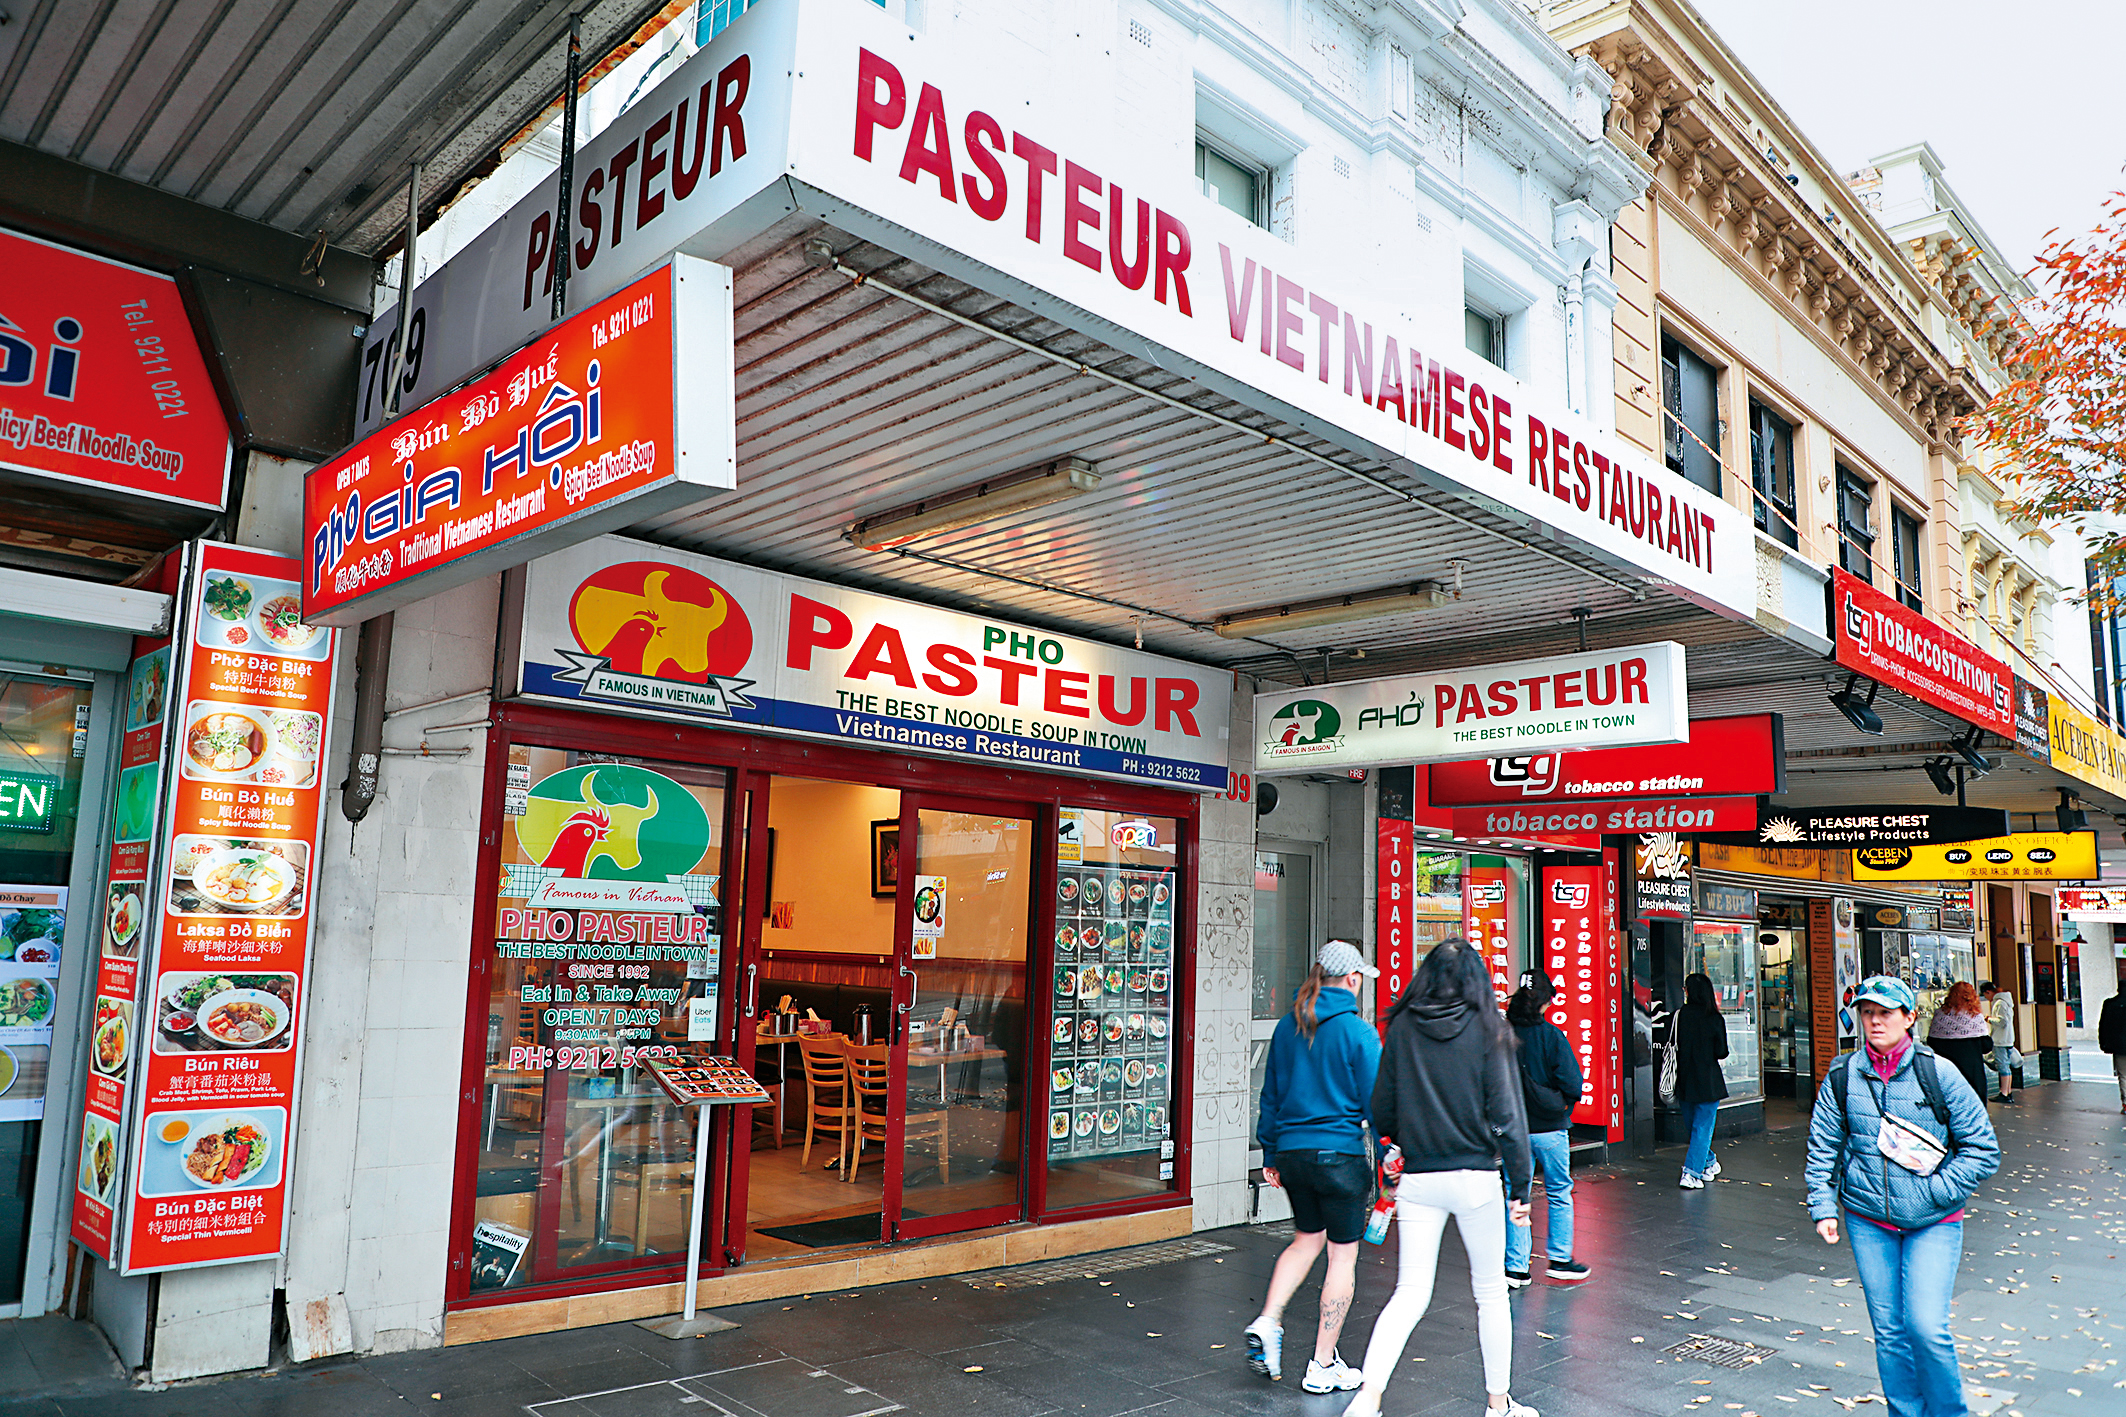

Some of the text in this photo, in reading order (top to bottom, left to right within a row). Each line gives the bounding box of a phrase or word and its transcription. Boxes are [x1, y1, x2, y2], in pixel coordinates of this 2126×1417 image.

[591, 293, 654, 349] Tel. 9211 0221
[853, 46, 1715, 574] PASTEUR VIETNAMESE RESTAURANT
[121, 299, 189, 419] Tel. 9211 0221
[0, 409, 182, 479] icy Beef Noodle Soup
[391, 419, 450, 465] Bún
[336, 455, 370, 492] OPEN 7 DAYS
[565, 440, 655, 505] Spicy Beef Noodle Soup
[400, 479, 545, 568] Traditional Vietnamese Restaurant
[983, 626, 1064, 665] PHO
[210, 652, 313, 679] Phở Đặc Biệt
[786, 592, 1201, 738] PASTEUR
[223, 669, 297, 691] 特別牛肉粉
[209, 682, 307, 701] Special Beef Noodle Soup
[598, 678, 716, 707] FAMOUS IN VIETNAM
[1434, 657, 1650, 729] PASTEUR
[836, 690, 1147, 755] THE BEST NOODLE SOUP IN TOWN
[1453, 713, 1636, 743] THE BEST NOODLE IN TOWN
[836, 713, 1082, 767] Vietnamese Restaurant
[1275, 747, 1299, 756] FAMOUS
[1307, 744, 1331, 752] SAIGON
[2052, 714, 2099, 769] ACEBEN
[1147, 761, 1173, 779] 9212
[1175, 765, 1201, 782] 5622
[1565, 775, 1704, 795] tobacco station
[201, 788, 295, 807] Bún Bò Huế
[199, 817, 291, 831] Spicy Beef Noodle Soup
[1486, 805, 1715, 833] tobacco station
[1810, 814, 1930, 829] PLEASURE CHEST
[1111, 826, 1156, 852] open
[1810, 829, 1930, 842] Lifestyle Products
[1860, 848, 1908, 858] ACEBEN
[2030, 852, 2053, 860] SELL
[13, 894, 36, 905] Chay
[541, 882, 685, 903] Famous in Vietnam
[1551, 879, 1590, 909] tsg
[1638, 880, 1690, 897] PLEASURE CHEST
[1638, 897, 1690, 912] Lifestyle Products
[1706, 892, 1745, 912] WE BUY
[1390, 836, 1401, 993] TOBACCO
[176, 921, 291, 938] Laksa Đồ Biển
[499, 907, 708, 945] PHO PASTEUR
[497, 942, 708, 962] THE BEST NOODLE IN TOWN
[1636, 938, 1647, 950] 705
[204, 954, 236, 962] Seafood
[568, 964, 650, 980] SINCE 1992
[521, 984, 681, 1006] Eat In & Take Away
[1607, 860, 1620, 1128] TOBACCO STATION
[543, 1008, 661, 1026] OPEN 7 DAYS
[694, 1008, 711, 1016] Uber
[694, 1016, 711, 1024] Eats
[1578, 916, 1594, 1106] tobacco station
[554, 1029, 600, 1041] 9:30AM
[185, 1055, 260, 1072] Bún Riêu
[508, 1045, 553, 1071] PH:
[556, 1046, 617, 1070] 9212
[155, 1194, 264, 1217] Bún Đặc Biệt
[147, 1210, 267, 1236] 特別的細米粉組合
[160, 1226, 253, 1244] Special Thin Vermicelli
[477, 1225, 523, 1251] hospitality
